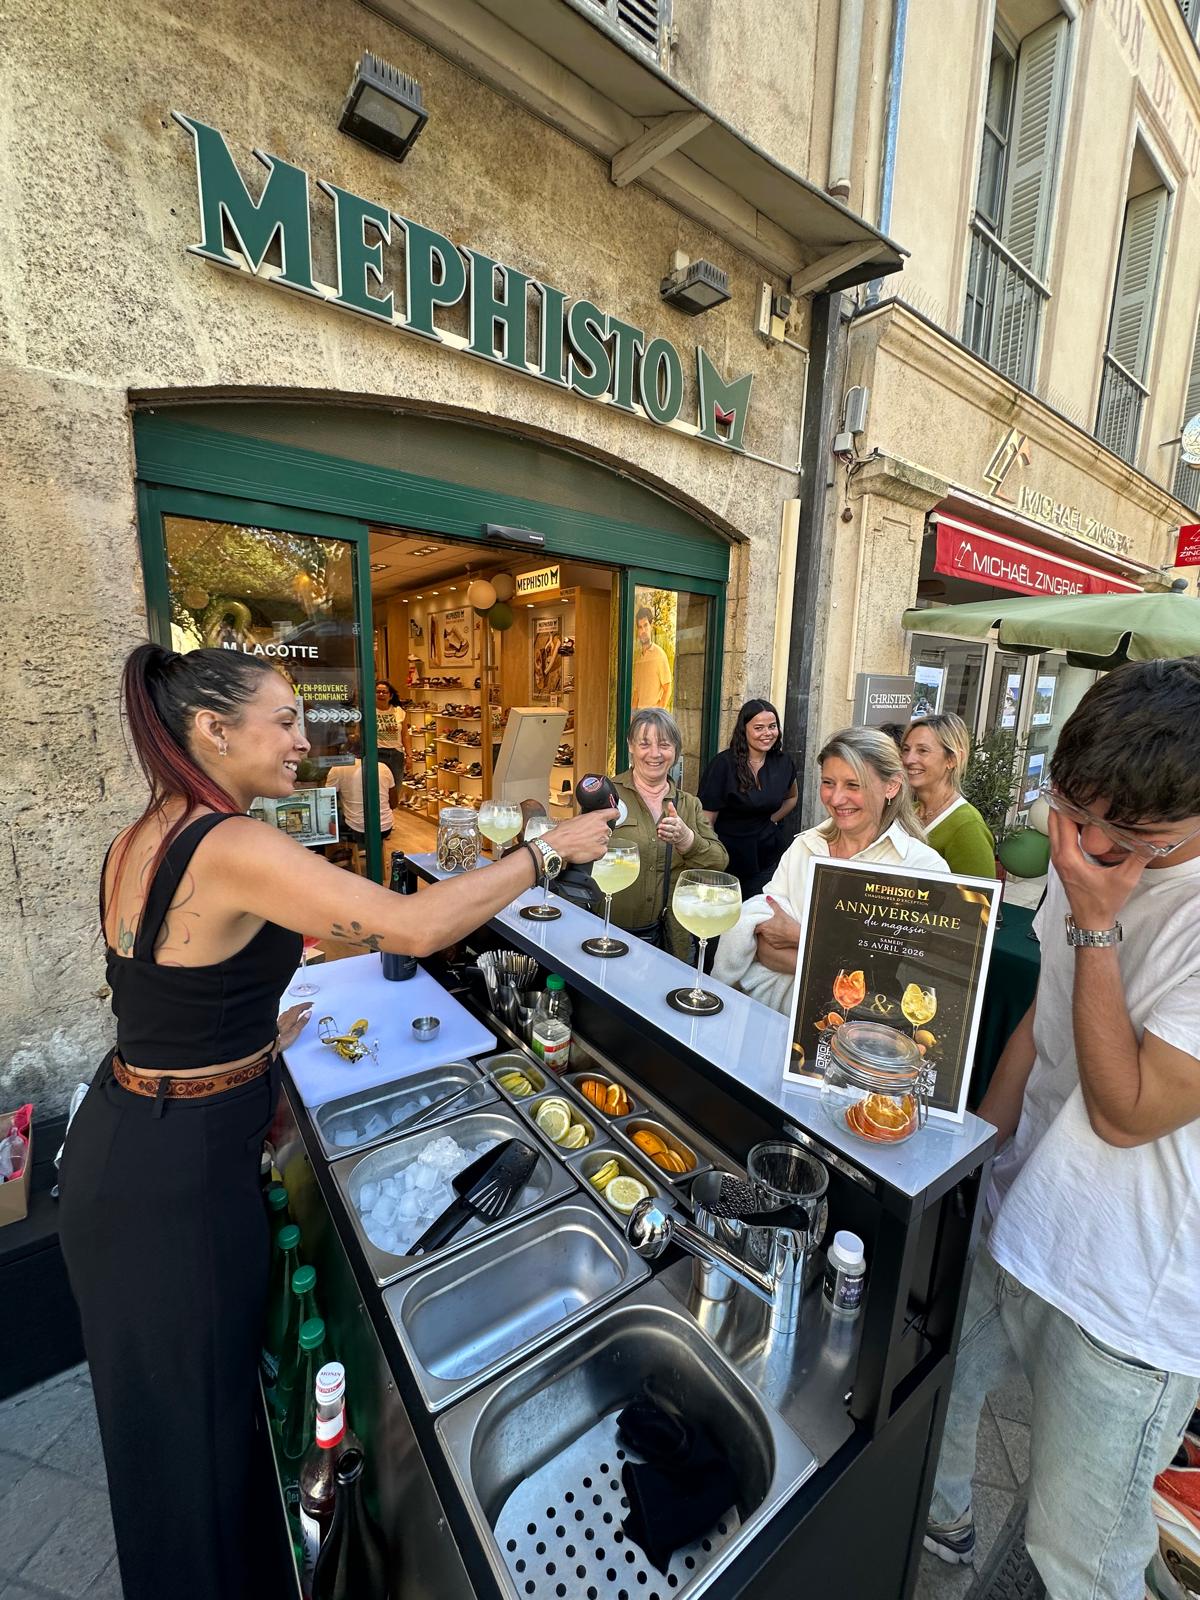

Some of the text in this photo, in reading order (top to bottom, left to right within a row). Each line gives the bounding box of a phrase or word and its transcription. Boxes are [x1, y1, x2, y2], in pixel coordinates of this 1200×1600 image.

[170, 110, 684, 426] MEPHISTO
[973, 552, 1033, 587] MICHAËL
[516, 573, 549, 592] MEPHISTO
[243, 642, 319, 659] LACOTTE
[865, 883, 915, 899] MEPHISTO
[834, 899, 961, 930] ANNIVERSAIRE
[864, 914, 927, 936] du magasin
[858, 939, 925, 958] 25 AVRIL 2026
[880, 938, 904, 946] SAMEDI
